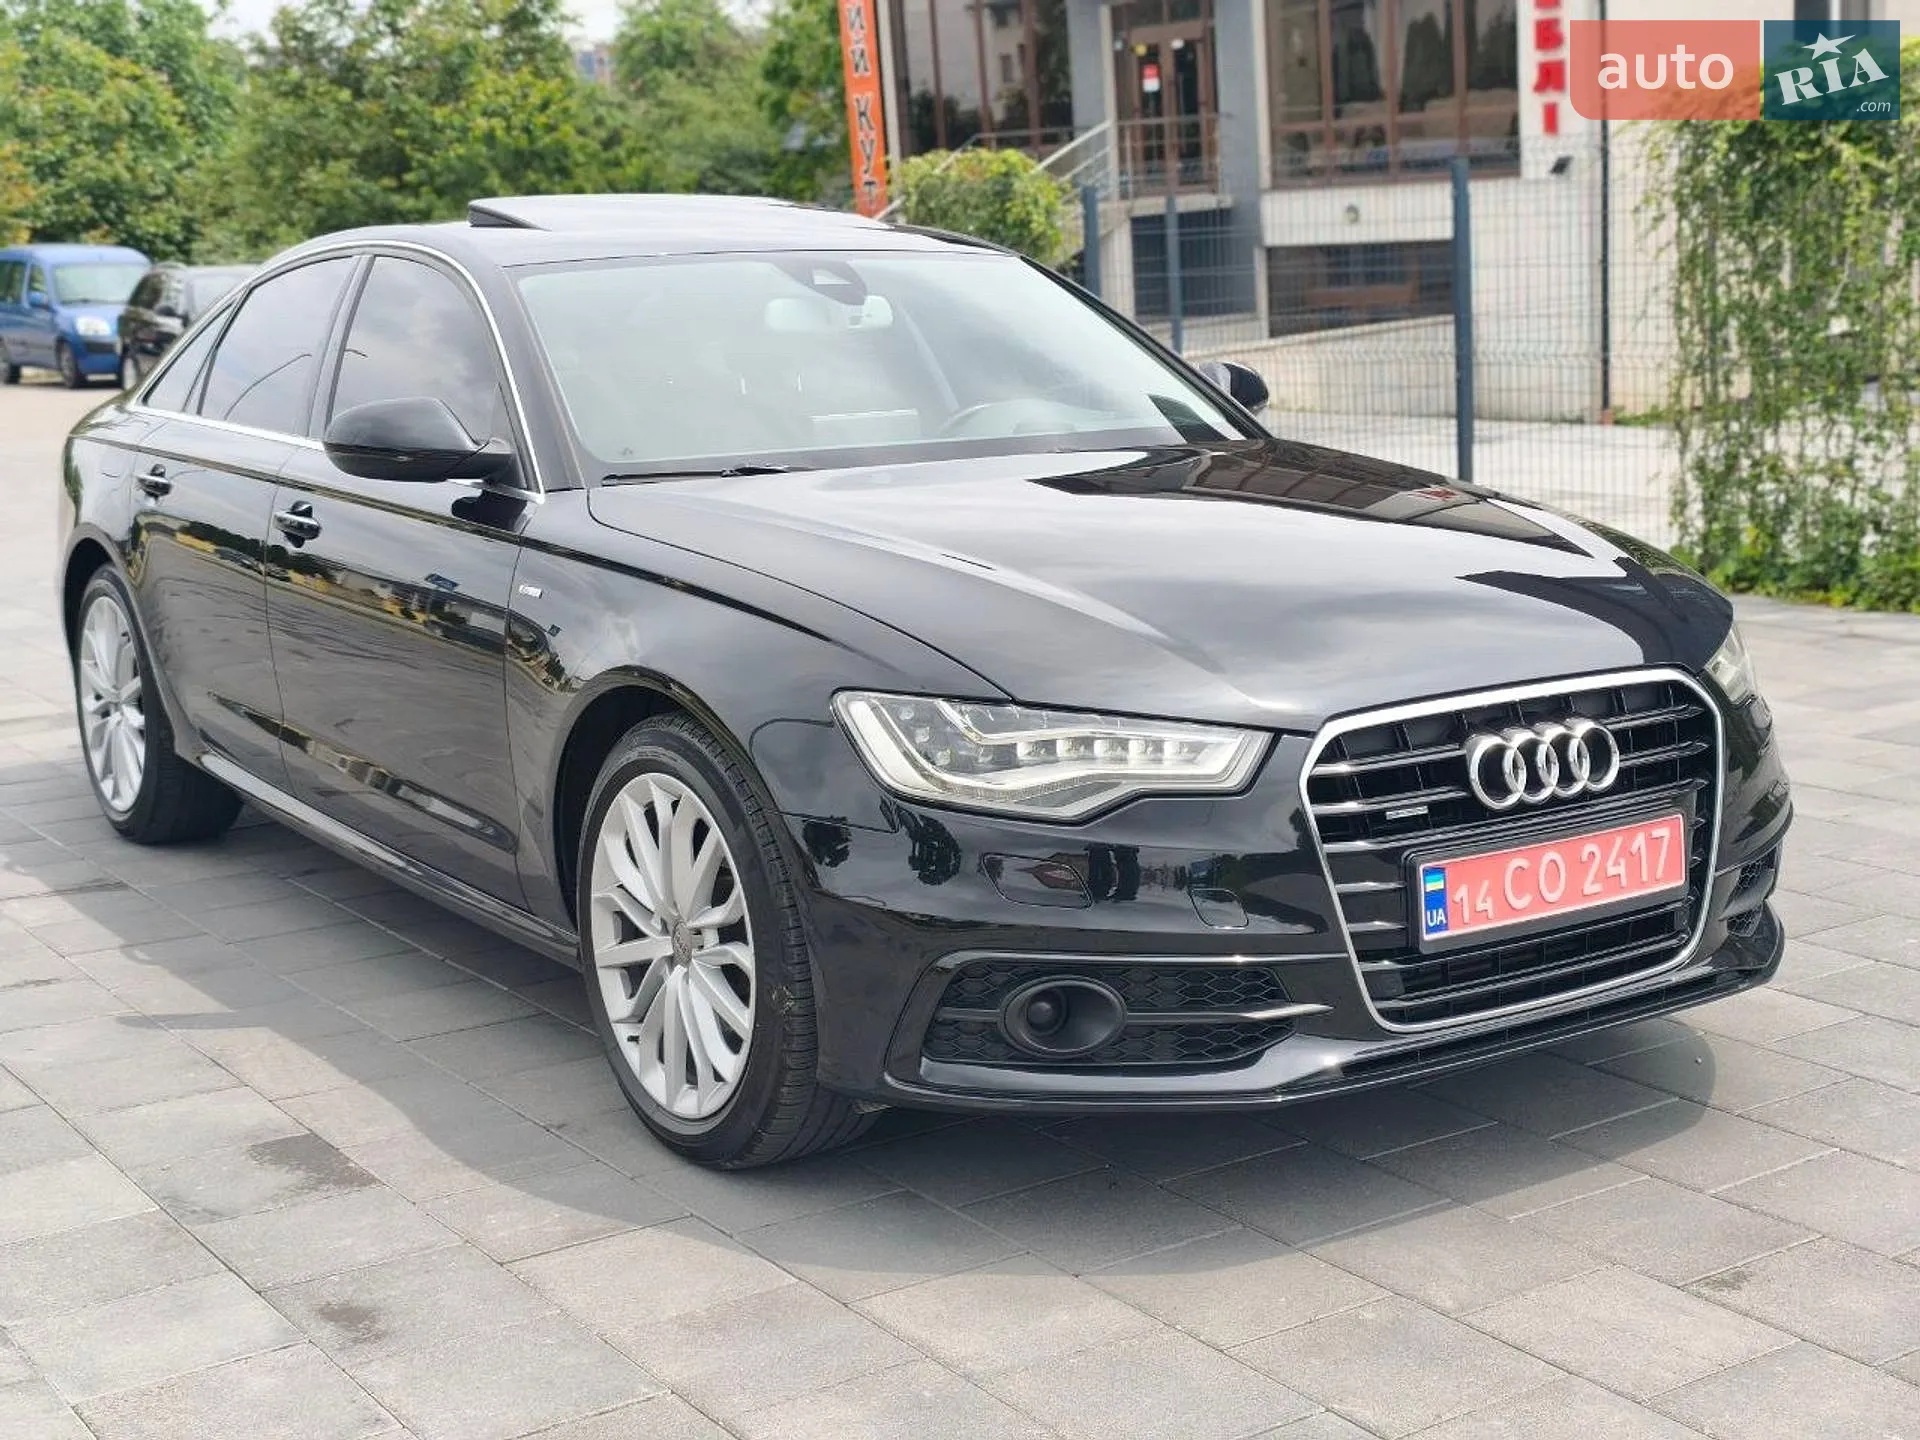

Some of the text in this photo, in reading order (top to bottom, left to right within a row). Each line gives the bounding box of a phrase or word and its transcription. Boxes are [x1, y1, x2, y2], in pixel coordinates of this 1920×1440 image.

[1533, 0, 1566, 135] БЛІ
[854, 94, 877, 208] КУТ
[1427, 908, 1446, 927] UA
[1452, 827, 1670, 924] 14 CO 2417
